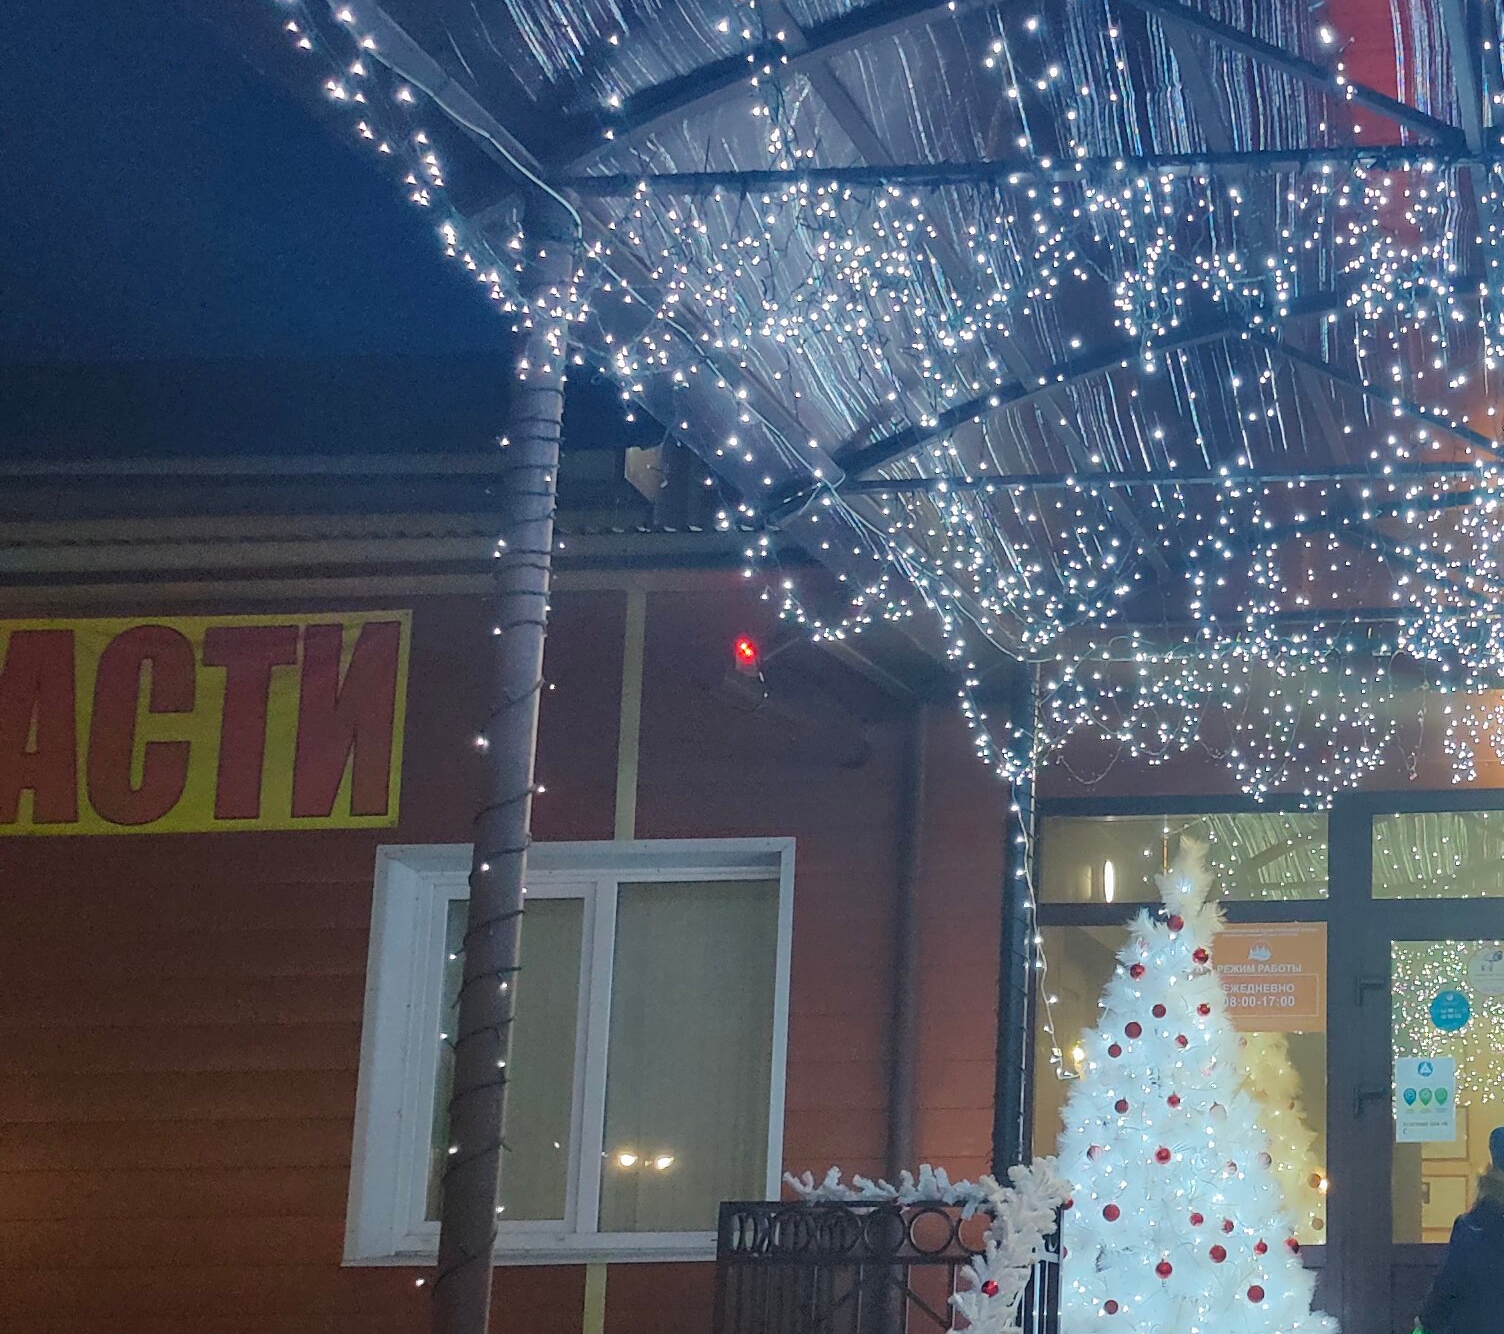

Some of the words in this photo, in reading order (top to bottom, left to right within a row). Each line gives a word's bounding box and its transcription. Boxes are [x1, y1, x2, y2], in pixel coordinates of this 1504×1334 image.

[0, 622, 401, 825] АСТИ
[1217, 964, 1256, 972] РЕЖИМ
[1258, 964, 1302, 972] РАБОТЫ
[1223, 984, 1295, 994] ЕЖЕДНЕВНО
[1224, 996, 1295, 1007] 08:00-17:00
